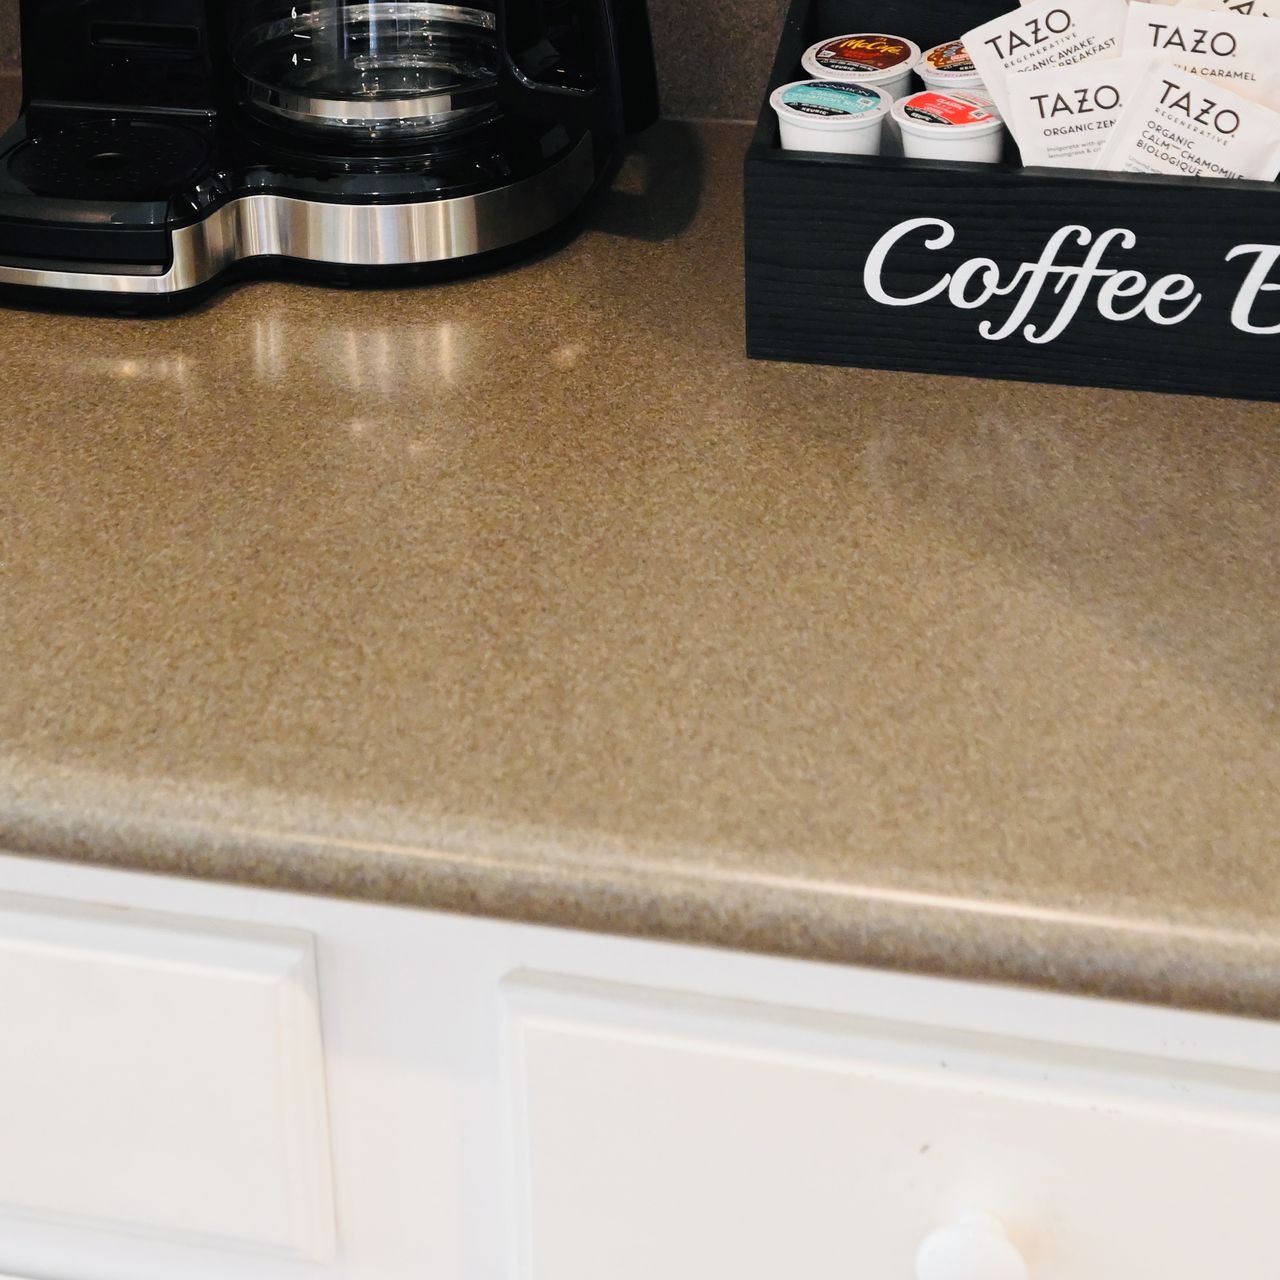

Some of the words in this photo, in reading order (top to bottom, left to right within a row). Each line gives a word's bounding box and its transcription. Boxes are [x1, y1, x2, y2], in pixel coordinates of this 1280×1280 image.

[291, 7, 297, 19] 6
[984, 9, 1072, 59] TAZO
[1004, 32, 1077, 68] REGENERATIVE
[1148, 23, 1236, 57] TAZO
[292, 54, 297, 66] 4
[1201, 67, 1256, 81] CARAMEL
[1030, 85, 1120, 119] TAZO
[1159, 80, 1240, 134] TAZO
[1044, 122, 1095, 137] ORGANIC
[1147, 120, 1195, 149] ORGANIC
[1154, 107, 1228, 146] REGENERATIVE
[863, 217, 1202, 345] Coffee
